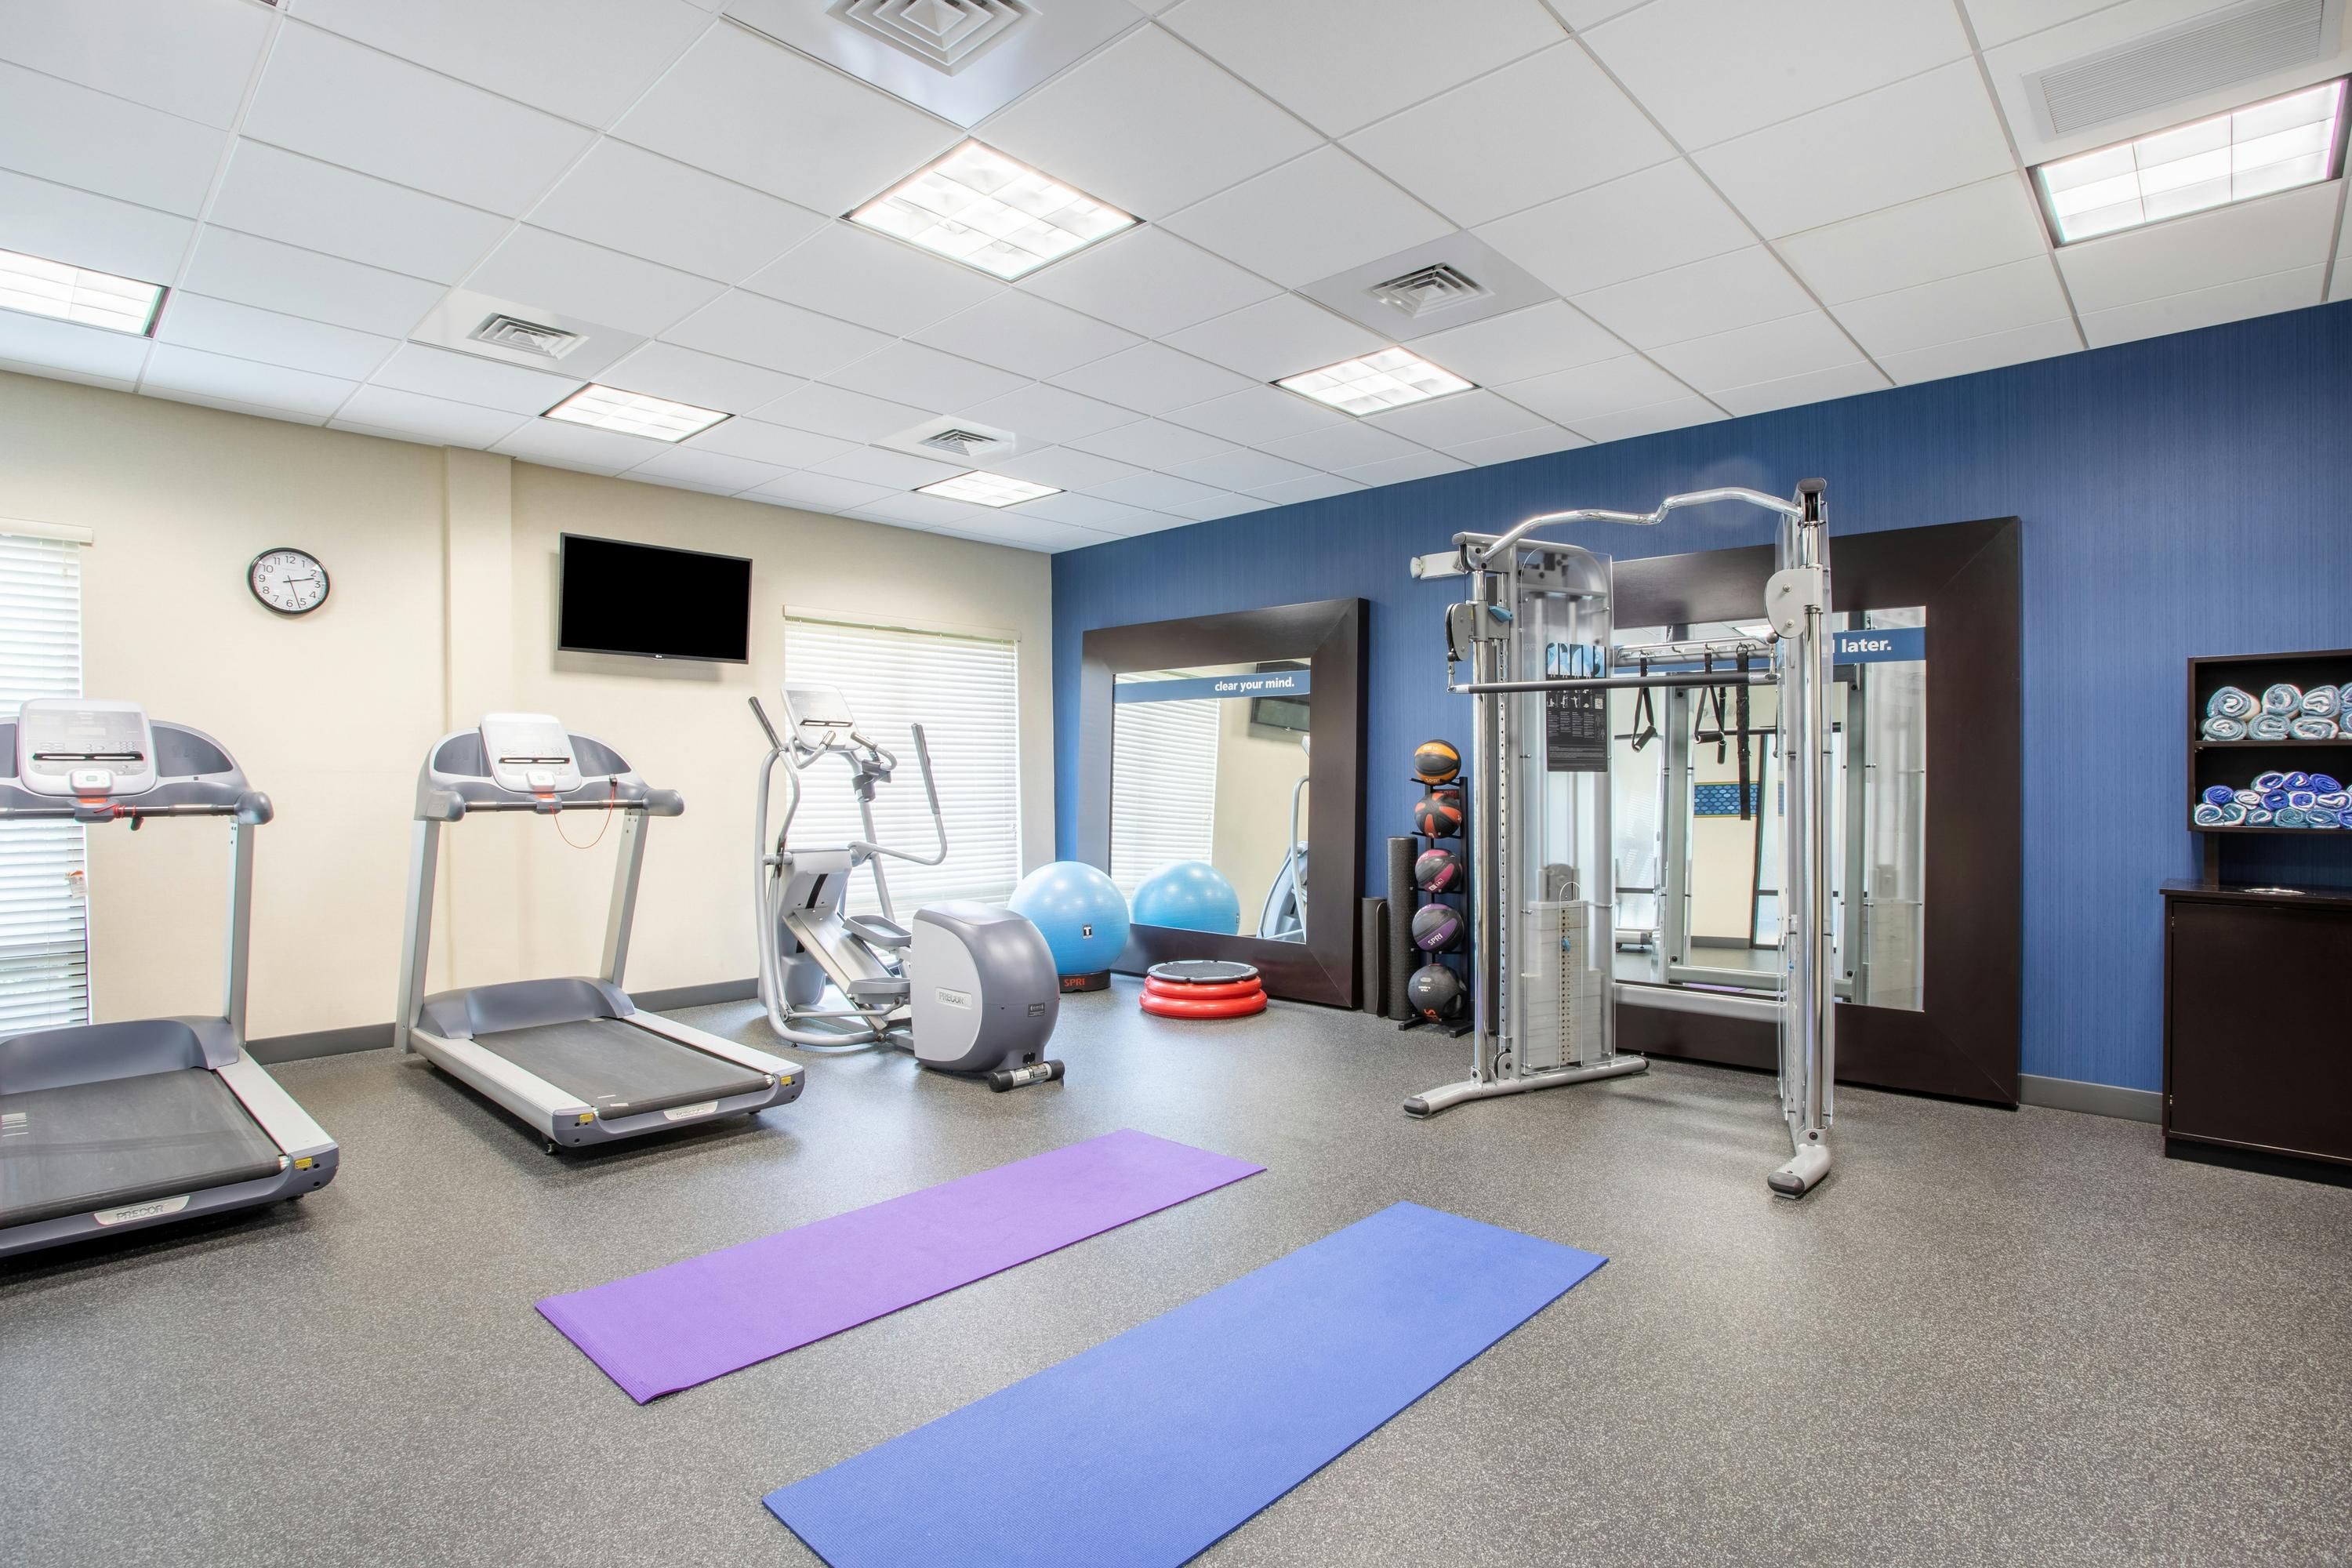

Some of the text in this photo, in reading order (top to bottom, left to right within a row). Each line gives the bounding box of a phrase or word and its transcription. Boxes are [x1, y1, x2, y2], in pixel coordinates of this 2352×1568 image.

[263, 564, 274, 573] 10
[1842, 638, 1892, 652] later.
[1214, 676, 1295, 693] clear your mind.
[1427, 933, 1443, 946] SPRI
[1064, 978, 1085, 987] SPRI
[115, 1204, 164, 1220] PRECOR
